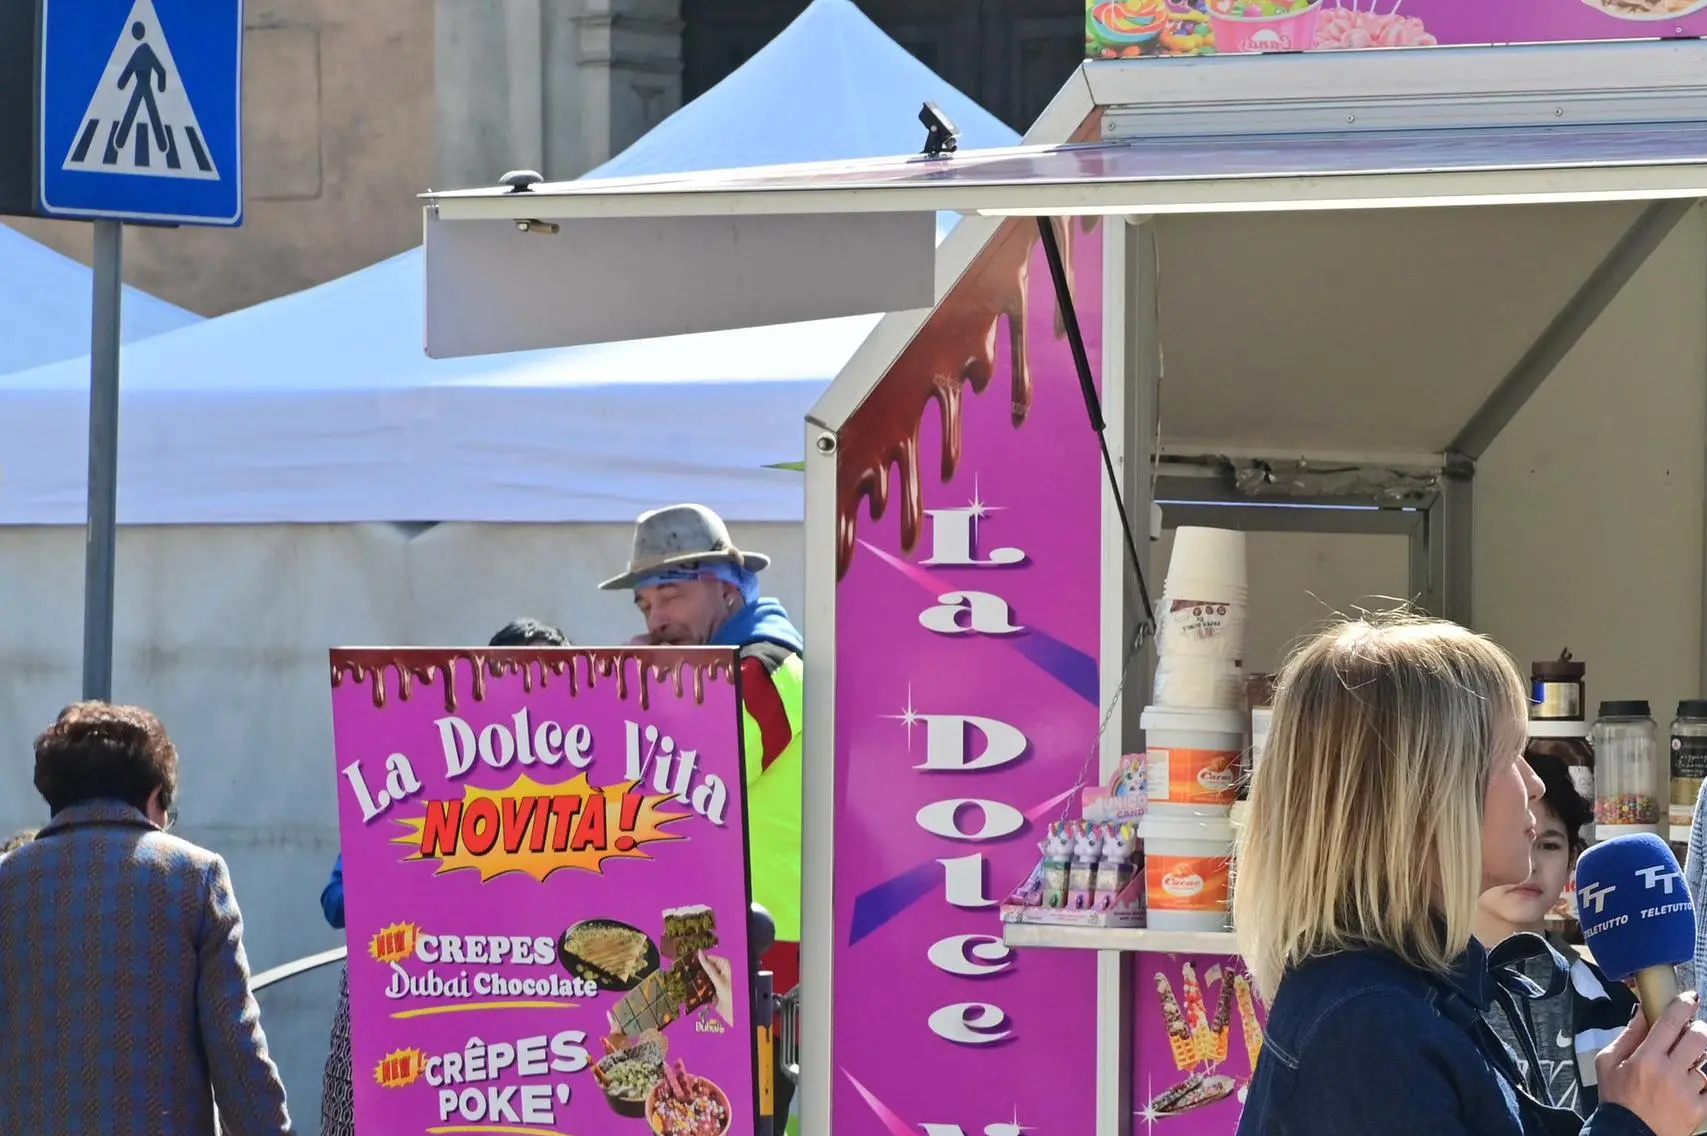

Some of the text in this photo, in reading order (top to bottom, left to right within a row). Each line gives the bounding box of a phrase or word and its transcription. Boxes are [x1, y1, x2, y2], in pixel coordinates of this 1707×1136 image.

[918, 507, 1026, 635] La
[342, 707, 729, 826] La Dolce Vita
[911, 714, 1028, 1044] Dolce
[1640, 902, 1694, 919] TELETUTTO
[415, 935, 556, 965] CREPES
[385, 960, 598, 998] Dubai Chocolate
[425, 1030, 590, 1086] CRÊPES
[439, 1083, 571, 1125] POKE'
